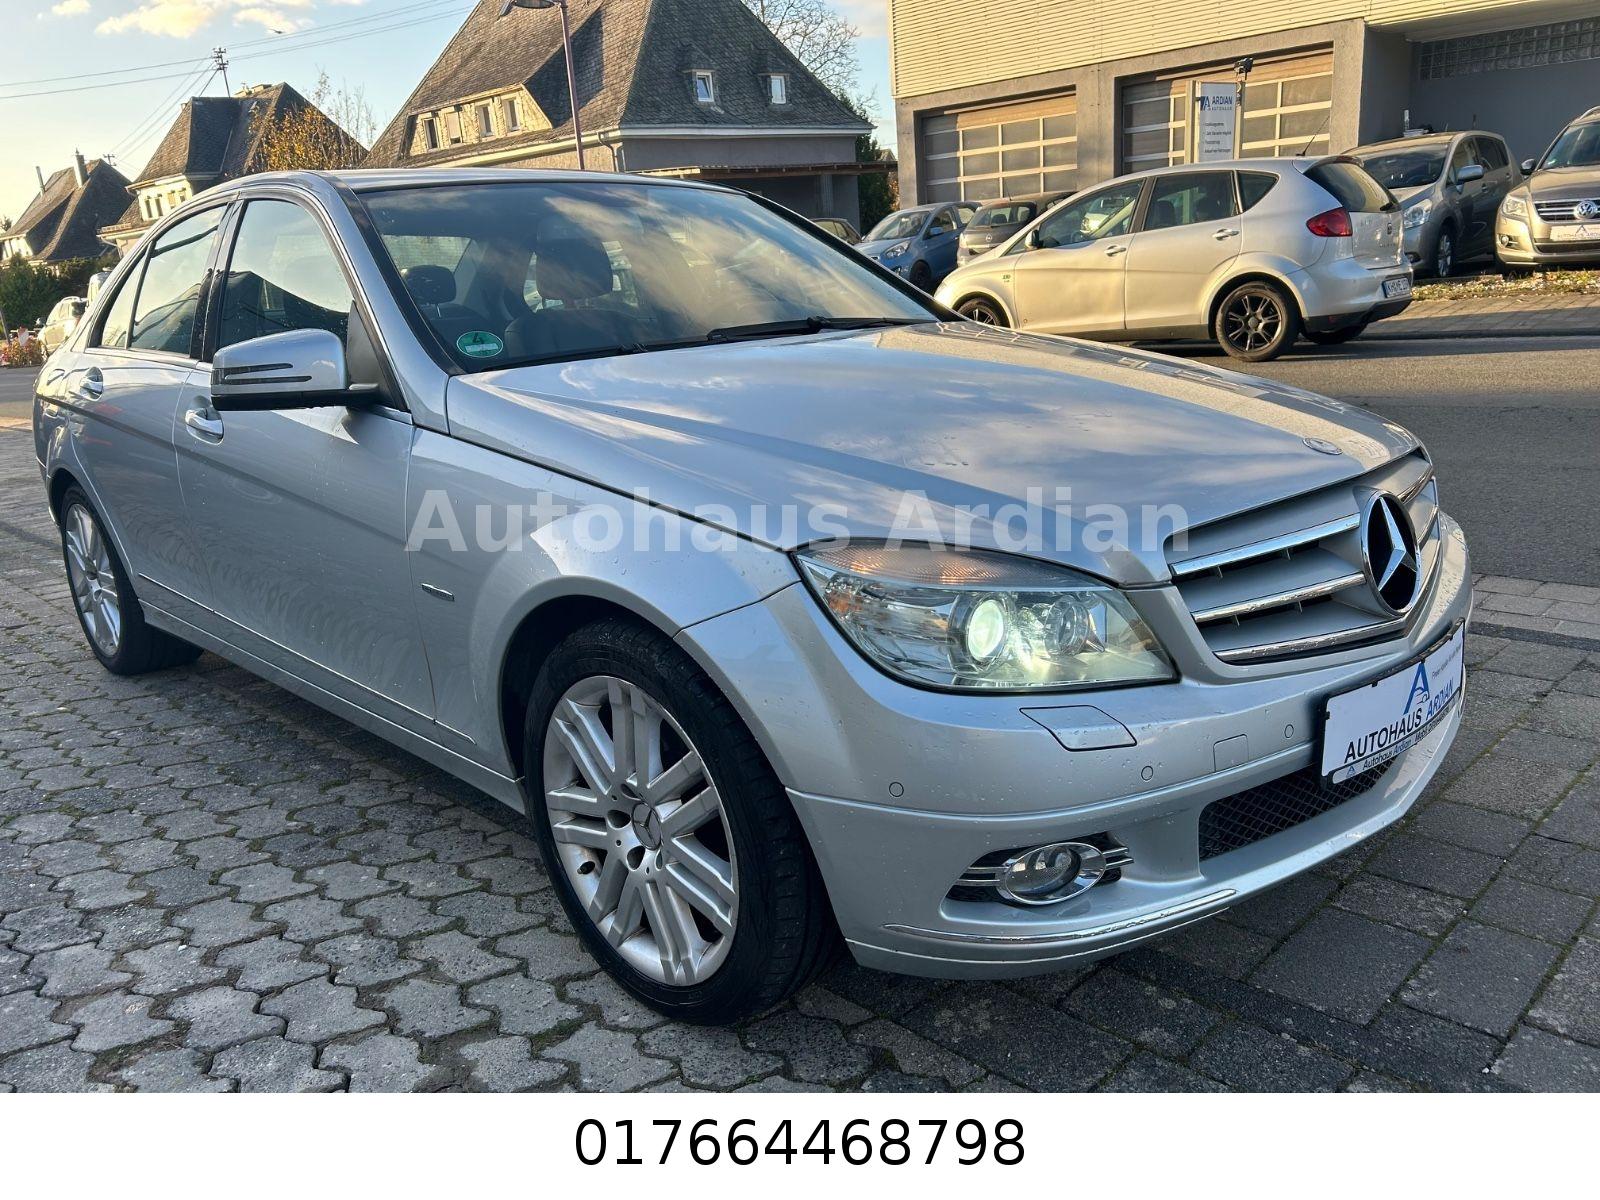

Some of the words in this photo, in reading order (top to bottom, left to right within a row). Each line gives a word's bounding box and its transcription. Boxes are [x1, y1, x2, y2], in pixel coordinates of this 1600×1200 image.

[1212, 96, 1233, 105] ARDIAN
[1344, 707, 1422, 764] AUTOHAUS
[1425, 677, 1454, 721] ARDIAN
[1362, 749, 1393, 771] Autohaus
[1393, 739, 1412, 756] Ardian
